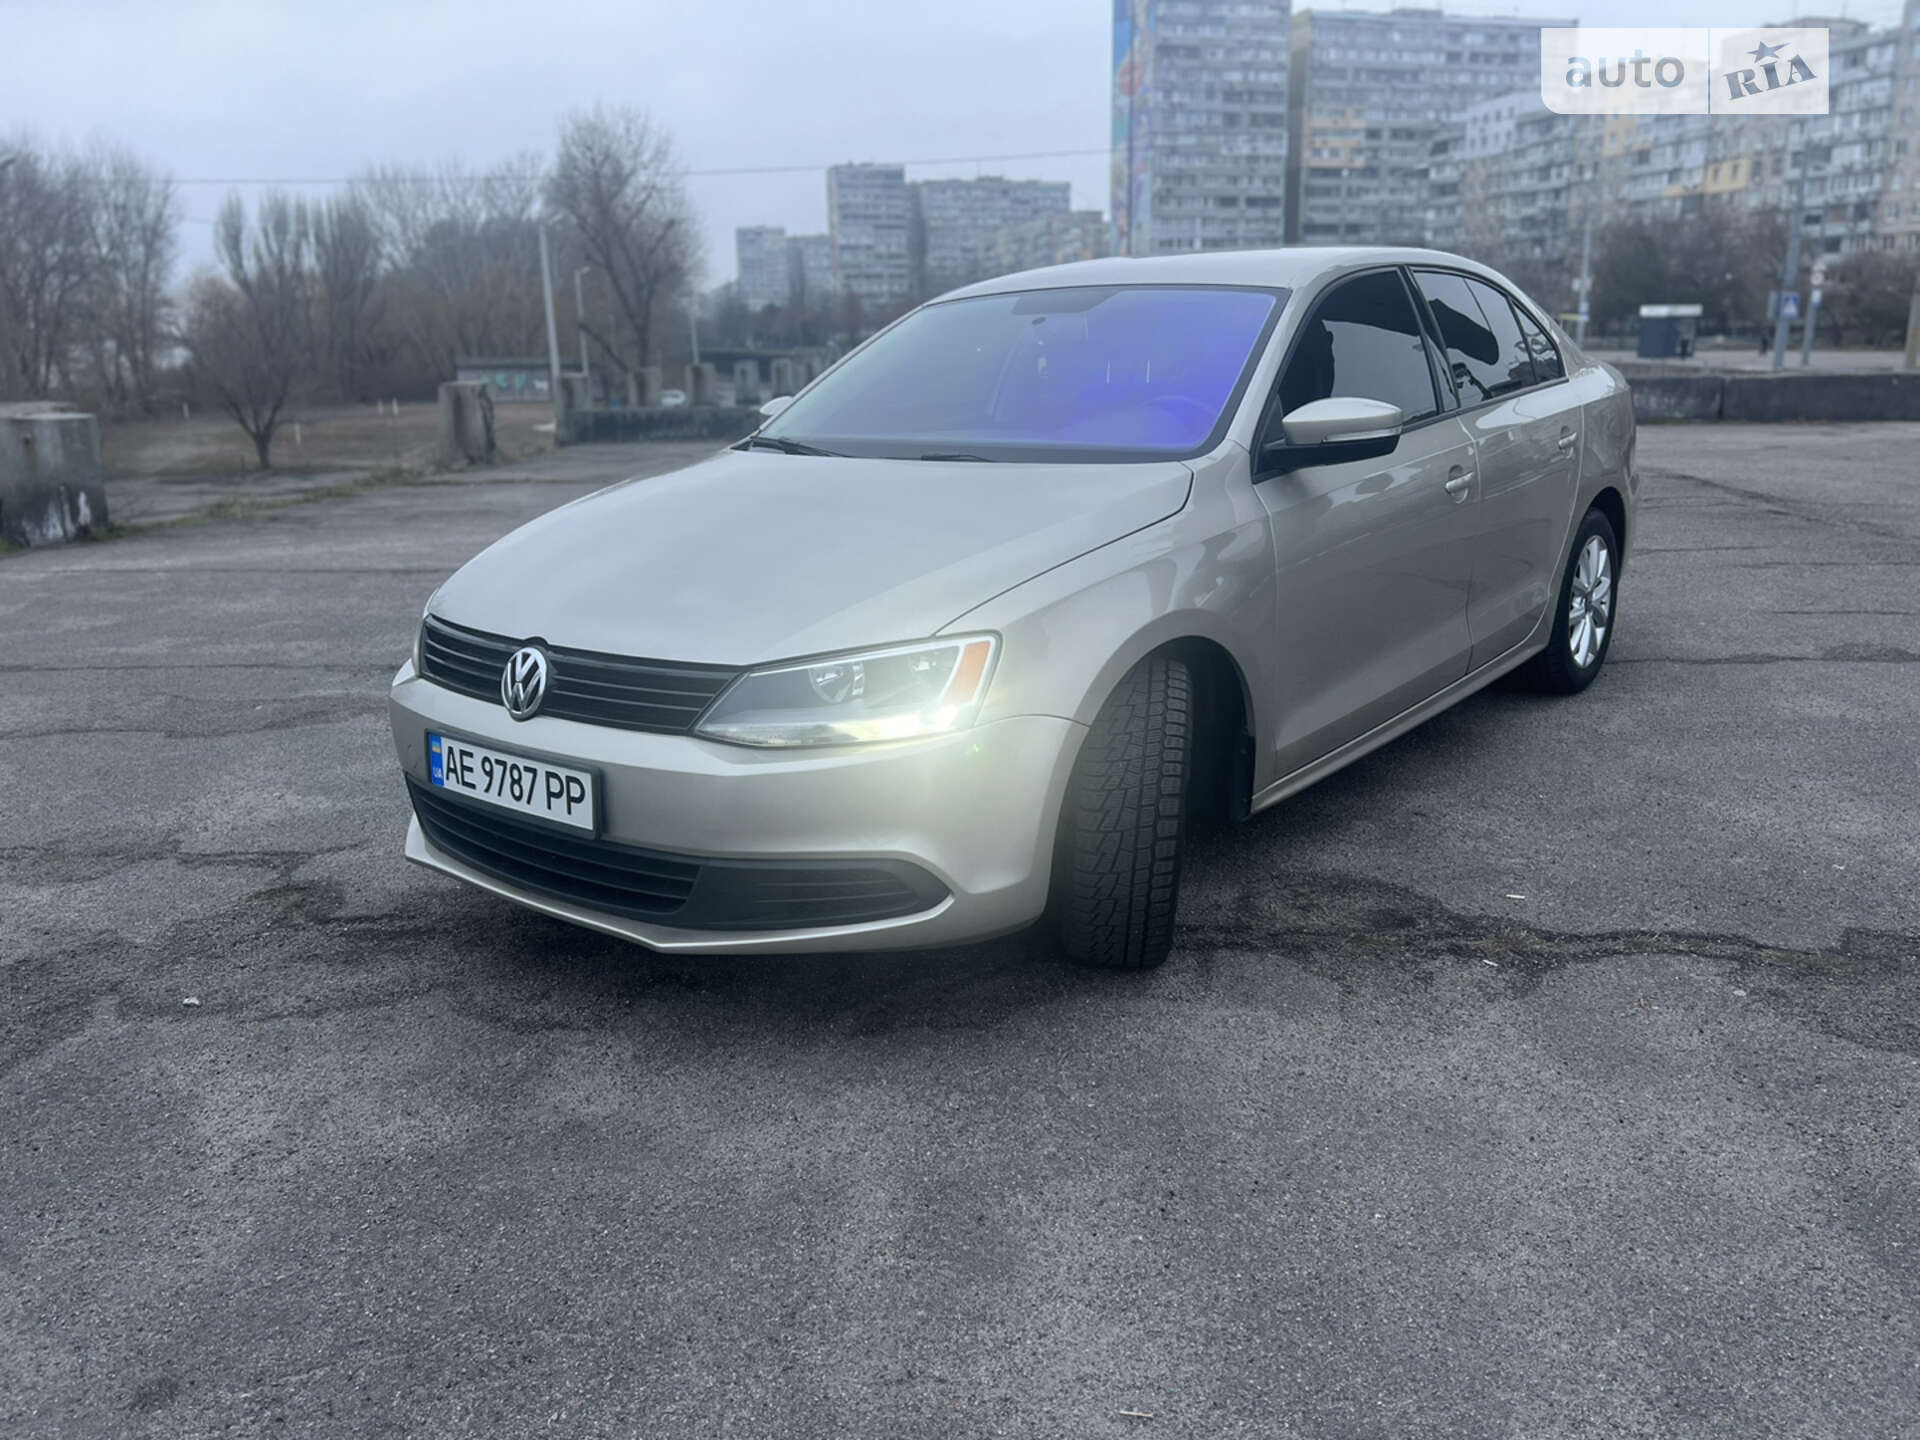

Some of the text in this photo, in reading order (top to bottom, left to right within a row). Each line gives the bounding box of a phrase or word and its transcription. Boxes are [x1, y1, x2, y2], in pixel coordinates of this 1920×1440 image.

[446, 746, 586, 815] AE 9787 PP
